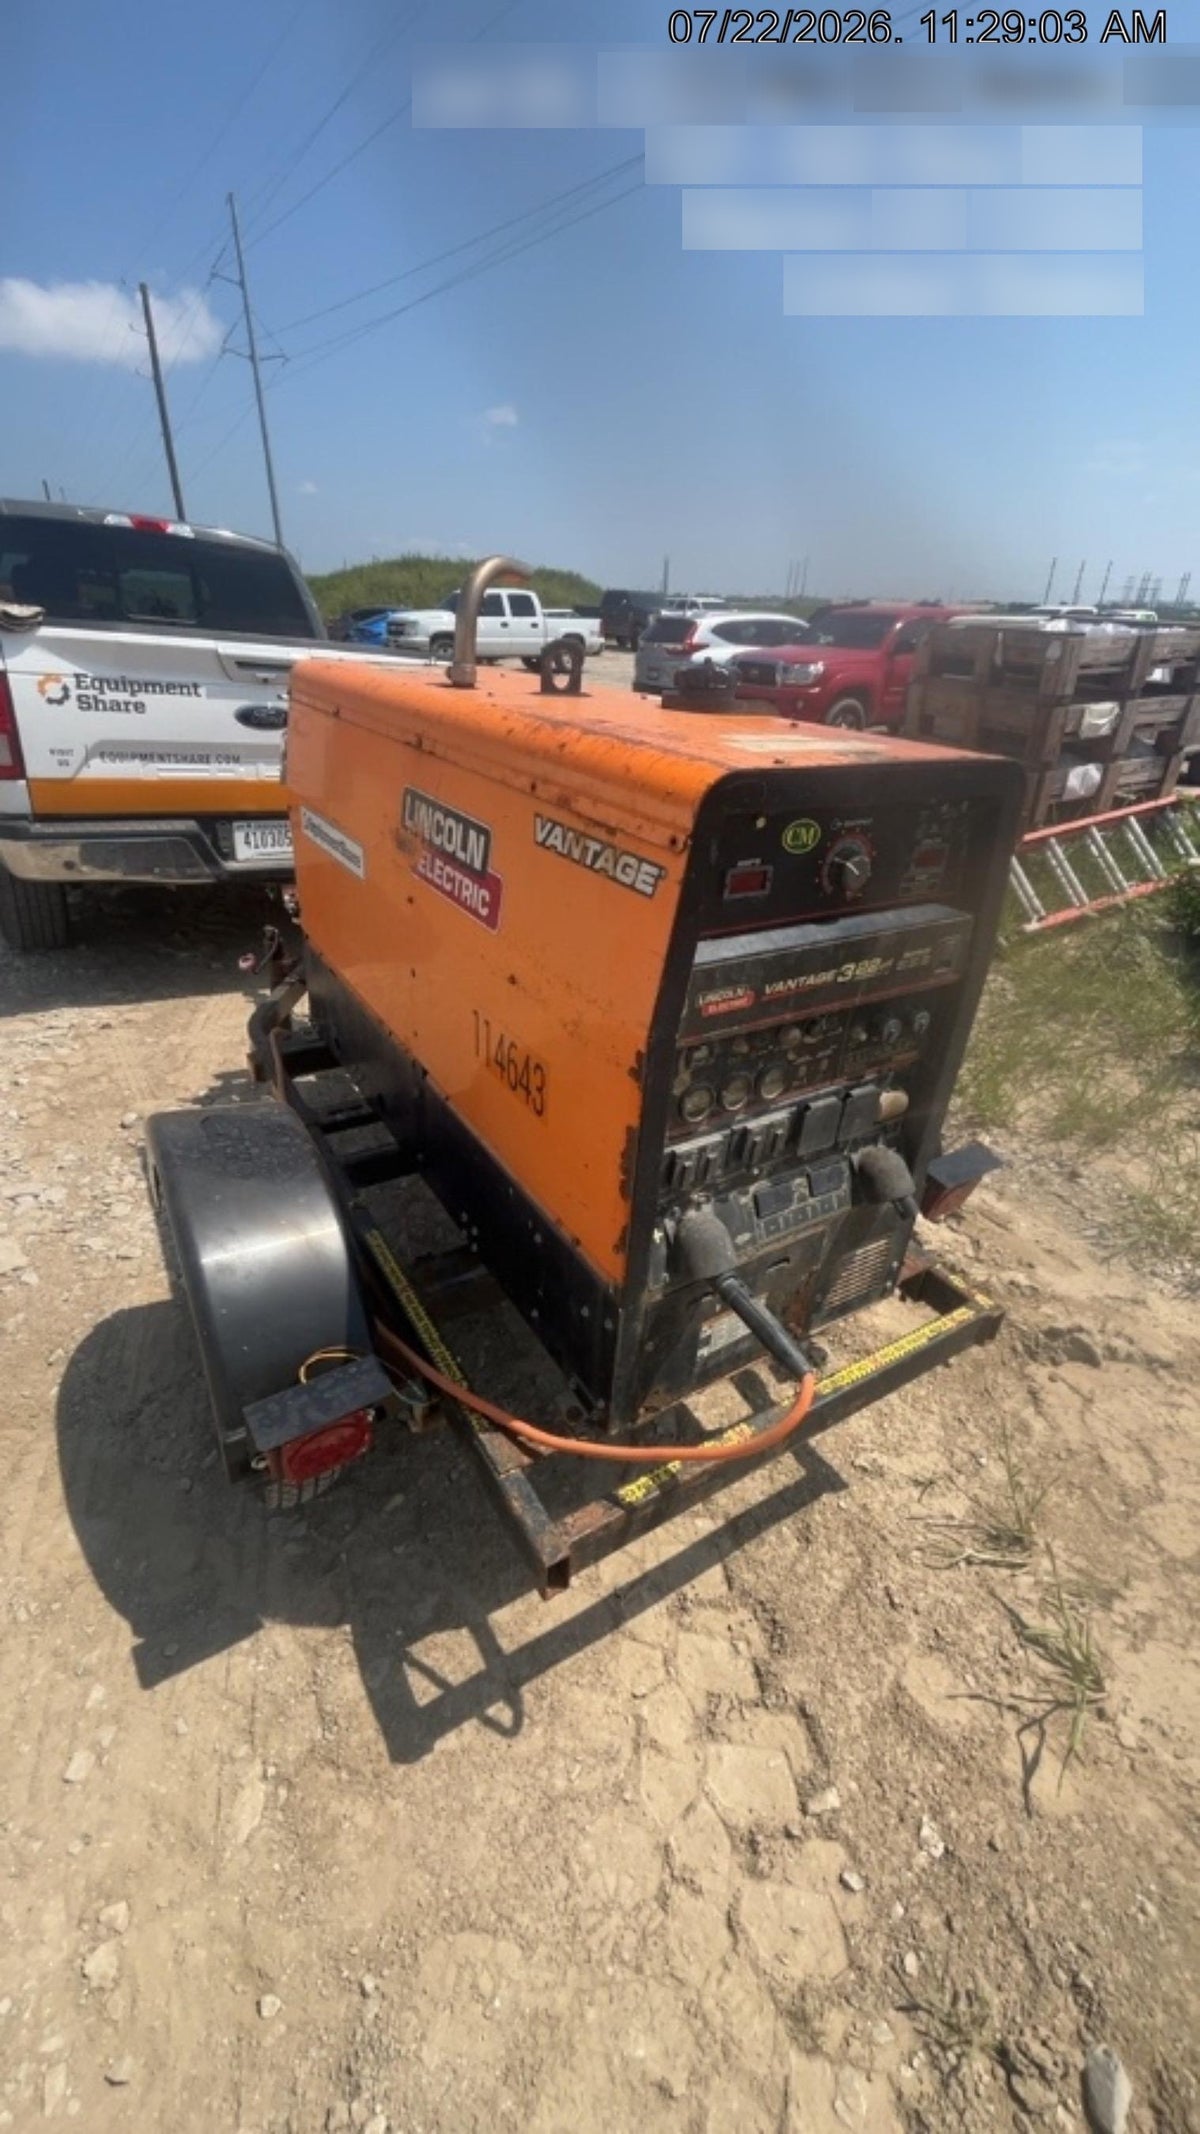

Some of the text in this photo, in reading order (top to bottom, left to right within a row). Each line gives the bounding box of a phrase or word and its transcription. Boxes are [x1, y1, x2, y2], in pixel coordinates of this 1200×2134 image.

[74, 673, 203, 697] Equipment
[76, 694, 147, 714] Share
[404, 794, 487, 872] LINCOLN
[534, 815, 660, 896] VANTAGE
[786, 826, 816, 846] CM
[416, 852, 490, 917] ELECTRIC
[472, 1009, 546, 1117] 114643
